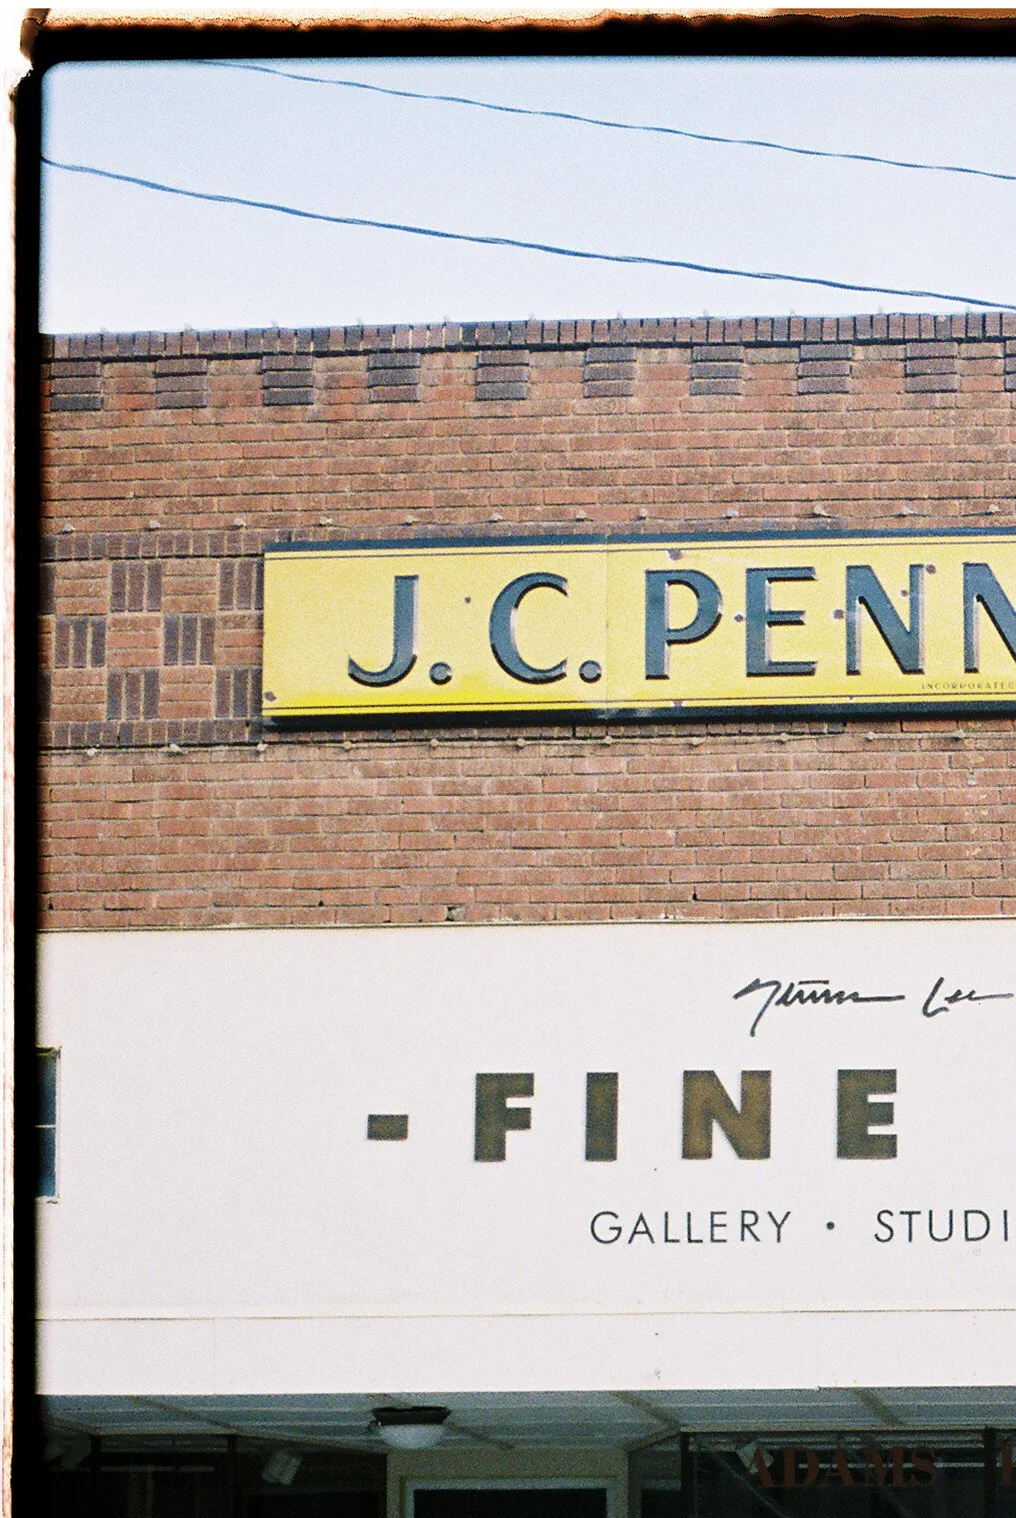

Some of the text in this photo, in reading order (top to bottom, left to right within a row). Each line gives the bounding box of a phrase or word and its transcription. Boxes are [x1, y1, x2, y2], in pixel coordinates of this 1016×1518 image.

[921, 682, 1015, 690] INCORPORATED
[473, 1068, 898, 1163] FINE
[590, 1209, 791, 1245] GALLERY
[747, 1445, 938, 1488] ADAMS
